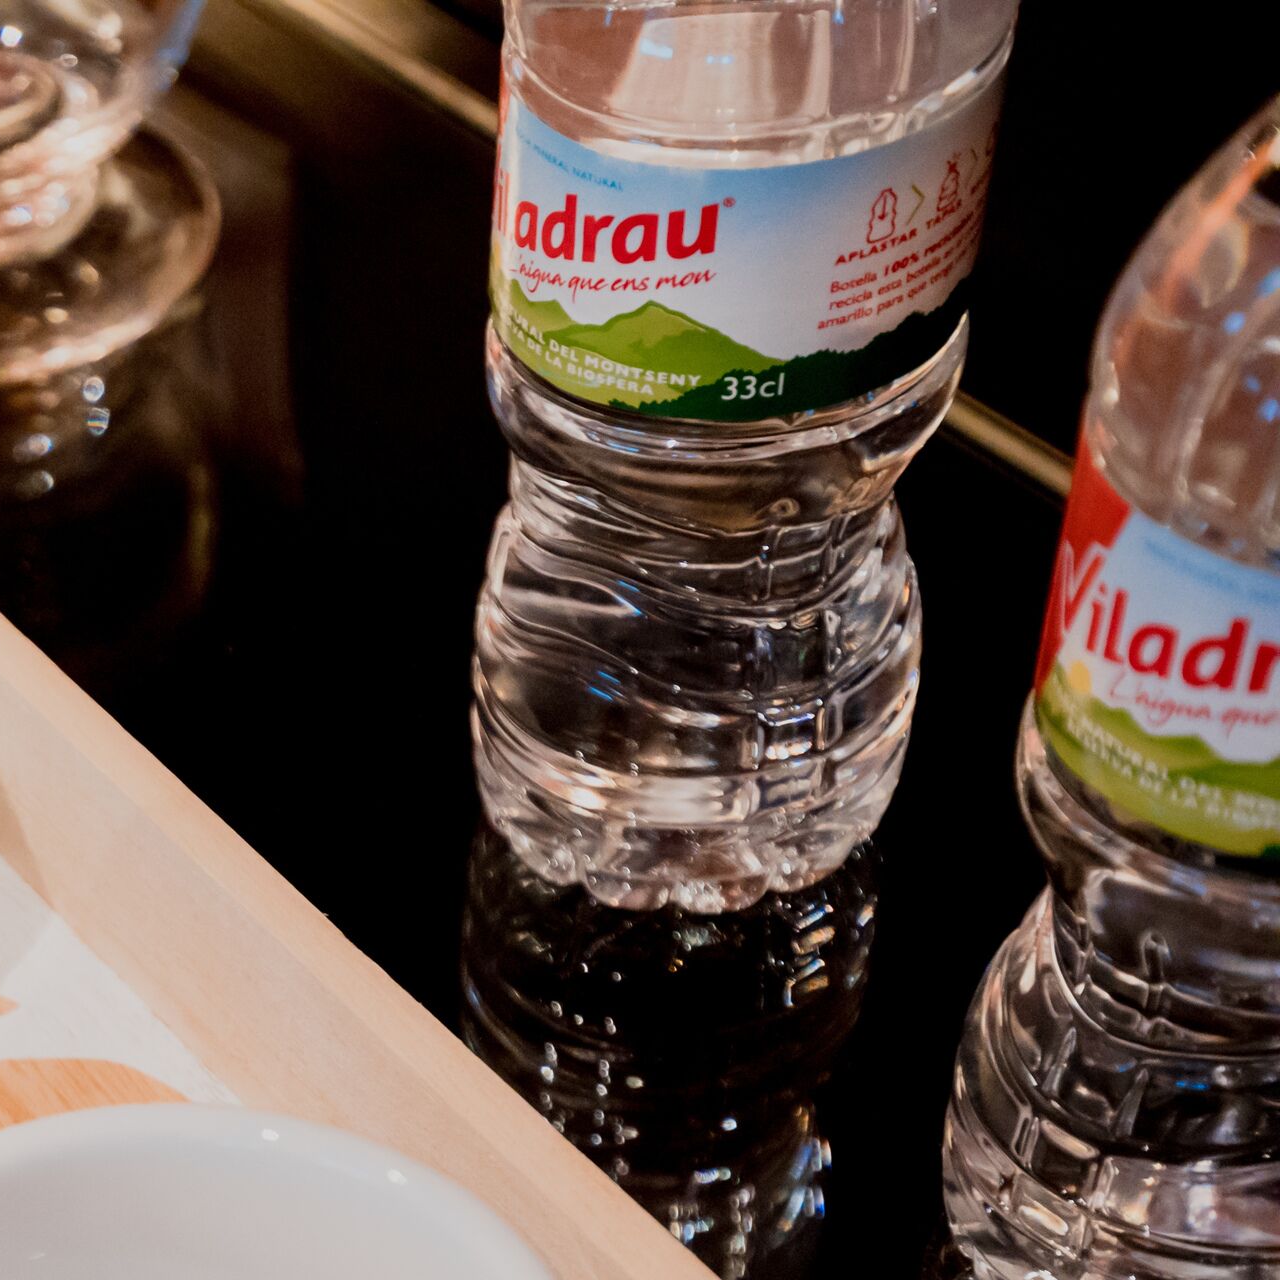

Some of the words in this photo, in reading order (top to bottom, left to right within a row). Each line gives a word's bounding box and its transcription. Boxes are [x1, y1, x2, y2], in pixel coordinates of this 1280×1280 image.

[834, 227, 918, 267] APLASTAR
[829, 271, 878, 294] Botella
[883, 253, 920, 277] 100%
[817, 306, 873, 331] amarillo
[876, 293, 905, 315] para
[828, 289, 873, 311] recicla
[545, 351, 563, 369] LA
[567, 364, 654, 396] BIOSFERA
[549, 338, 580, 363] DEL
[584, 354, 702, 387] MONTSENY
[720, 371, 786, 402] 33cl
